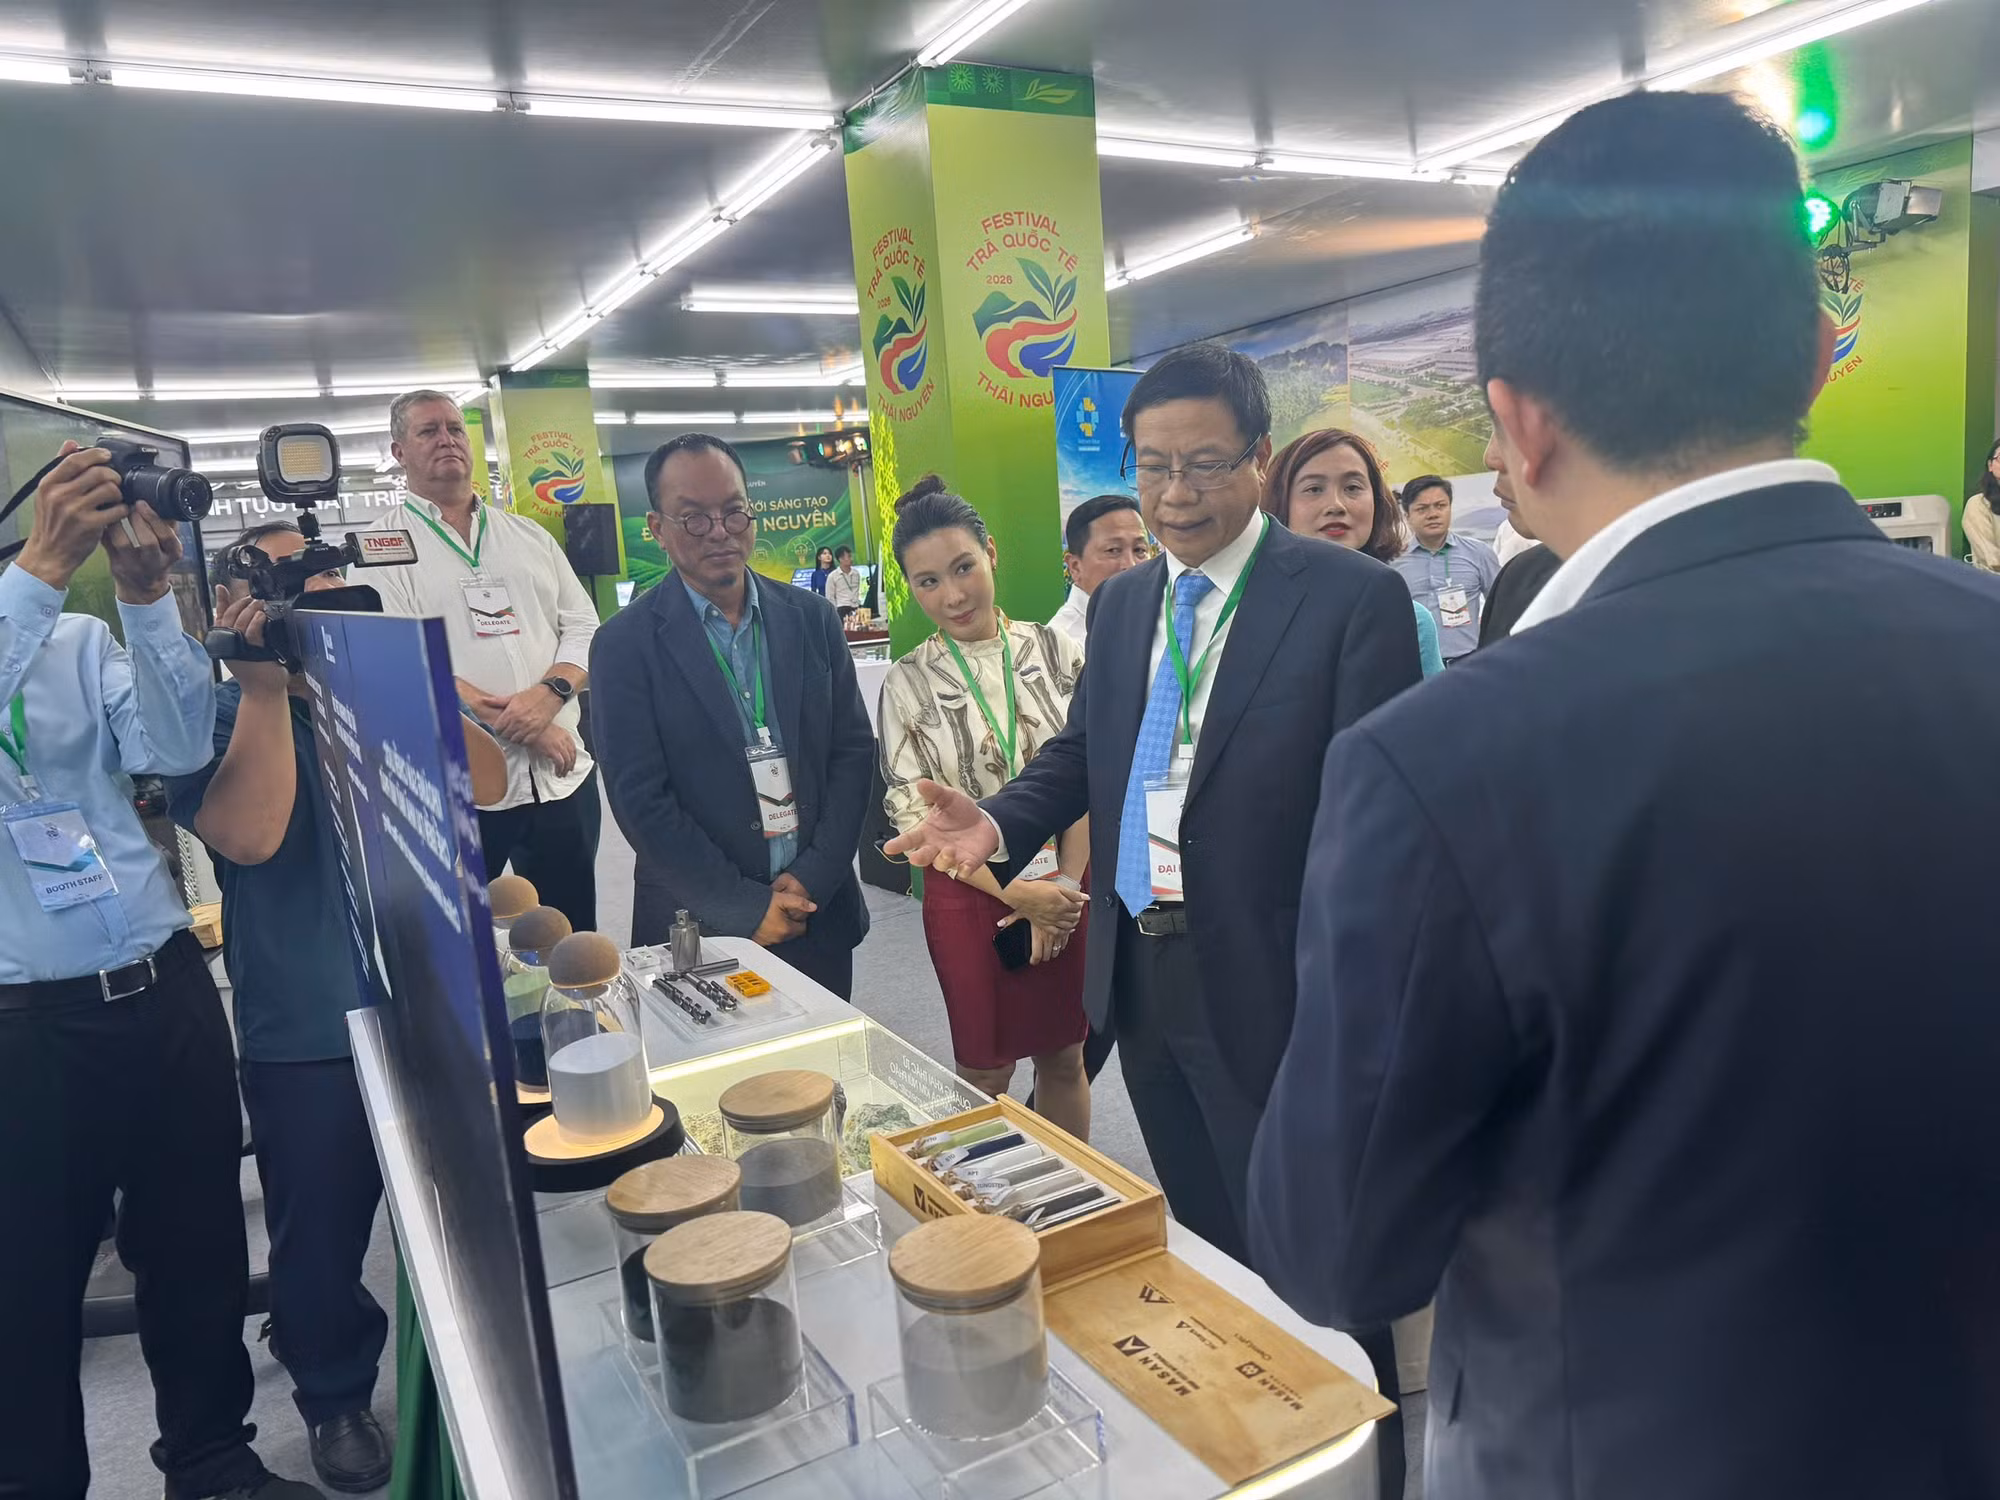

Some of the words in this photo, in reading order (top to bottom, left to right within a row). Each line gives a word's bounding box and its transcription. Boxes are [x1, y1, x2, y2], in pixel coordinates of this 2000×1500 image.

[981, 211, 1061, 238] FESTIVAL
[872, 226, 914, 262] FESTIVAL
[1003, 228, 1052, 253] QUỐC
[1056, 247, 1079, 273] TẾ
[882, 245, 910, 271] QUỐC
[912, 254, 926, 279] TẾ
[986, 274, 1013, 285] 2026
[876, 295, 892, 310] 2026
[1826, 355, 1863, 384] UYÊN
[899, 378, 935, 422] NGUYÊN
[1020, 391, 1054, 408] NGU
[531, 431, 573, 443] FESTIVAL
[361, 486, 406, 508] TRIỂ
[751, 499, 767, 512] ỚI
[769, 497, 802, 512] SÁNG
[803, 496, 828, 511] TẠO
[762, 510, 837, 532] NGUYÊN
[768, 808, 798, 821] DELEGATE
[1157, 864, 1177, 876] ĐẠI
[45, 880, 78, 895] BOOTH
[78, 873, 104, 887] STAFF
[1138, 1356, 1193, 1397] MASAN
[1257, 1378, 1304, 1411] MASAN
